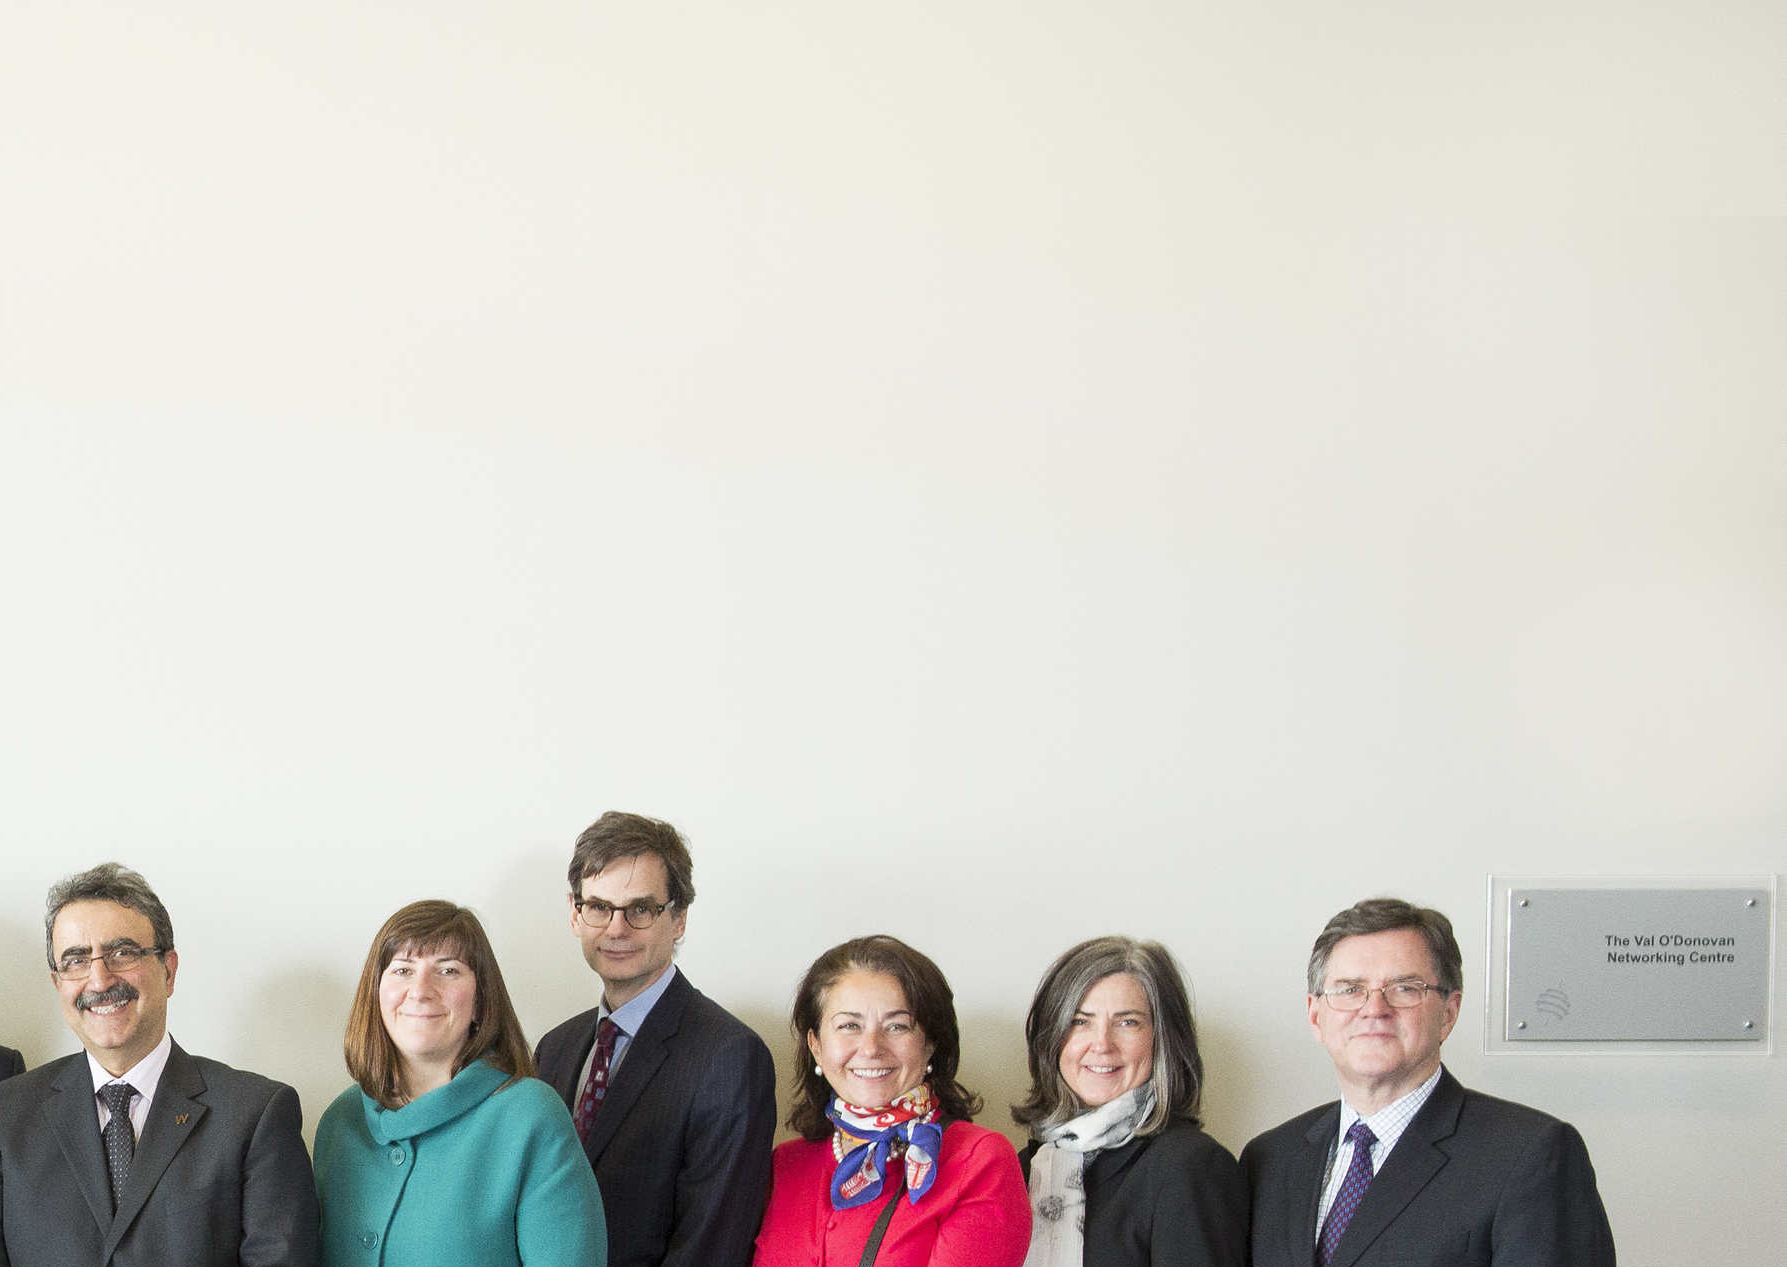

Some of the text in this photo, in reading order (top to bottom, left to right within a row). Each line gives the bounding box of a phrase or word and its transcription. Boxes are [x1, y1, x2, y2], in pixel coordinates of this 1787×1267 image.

[1605, 935, 1735, 946] The Val O'Donovan
[1607, 951, 1735, 965] Networking Centre
